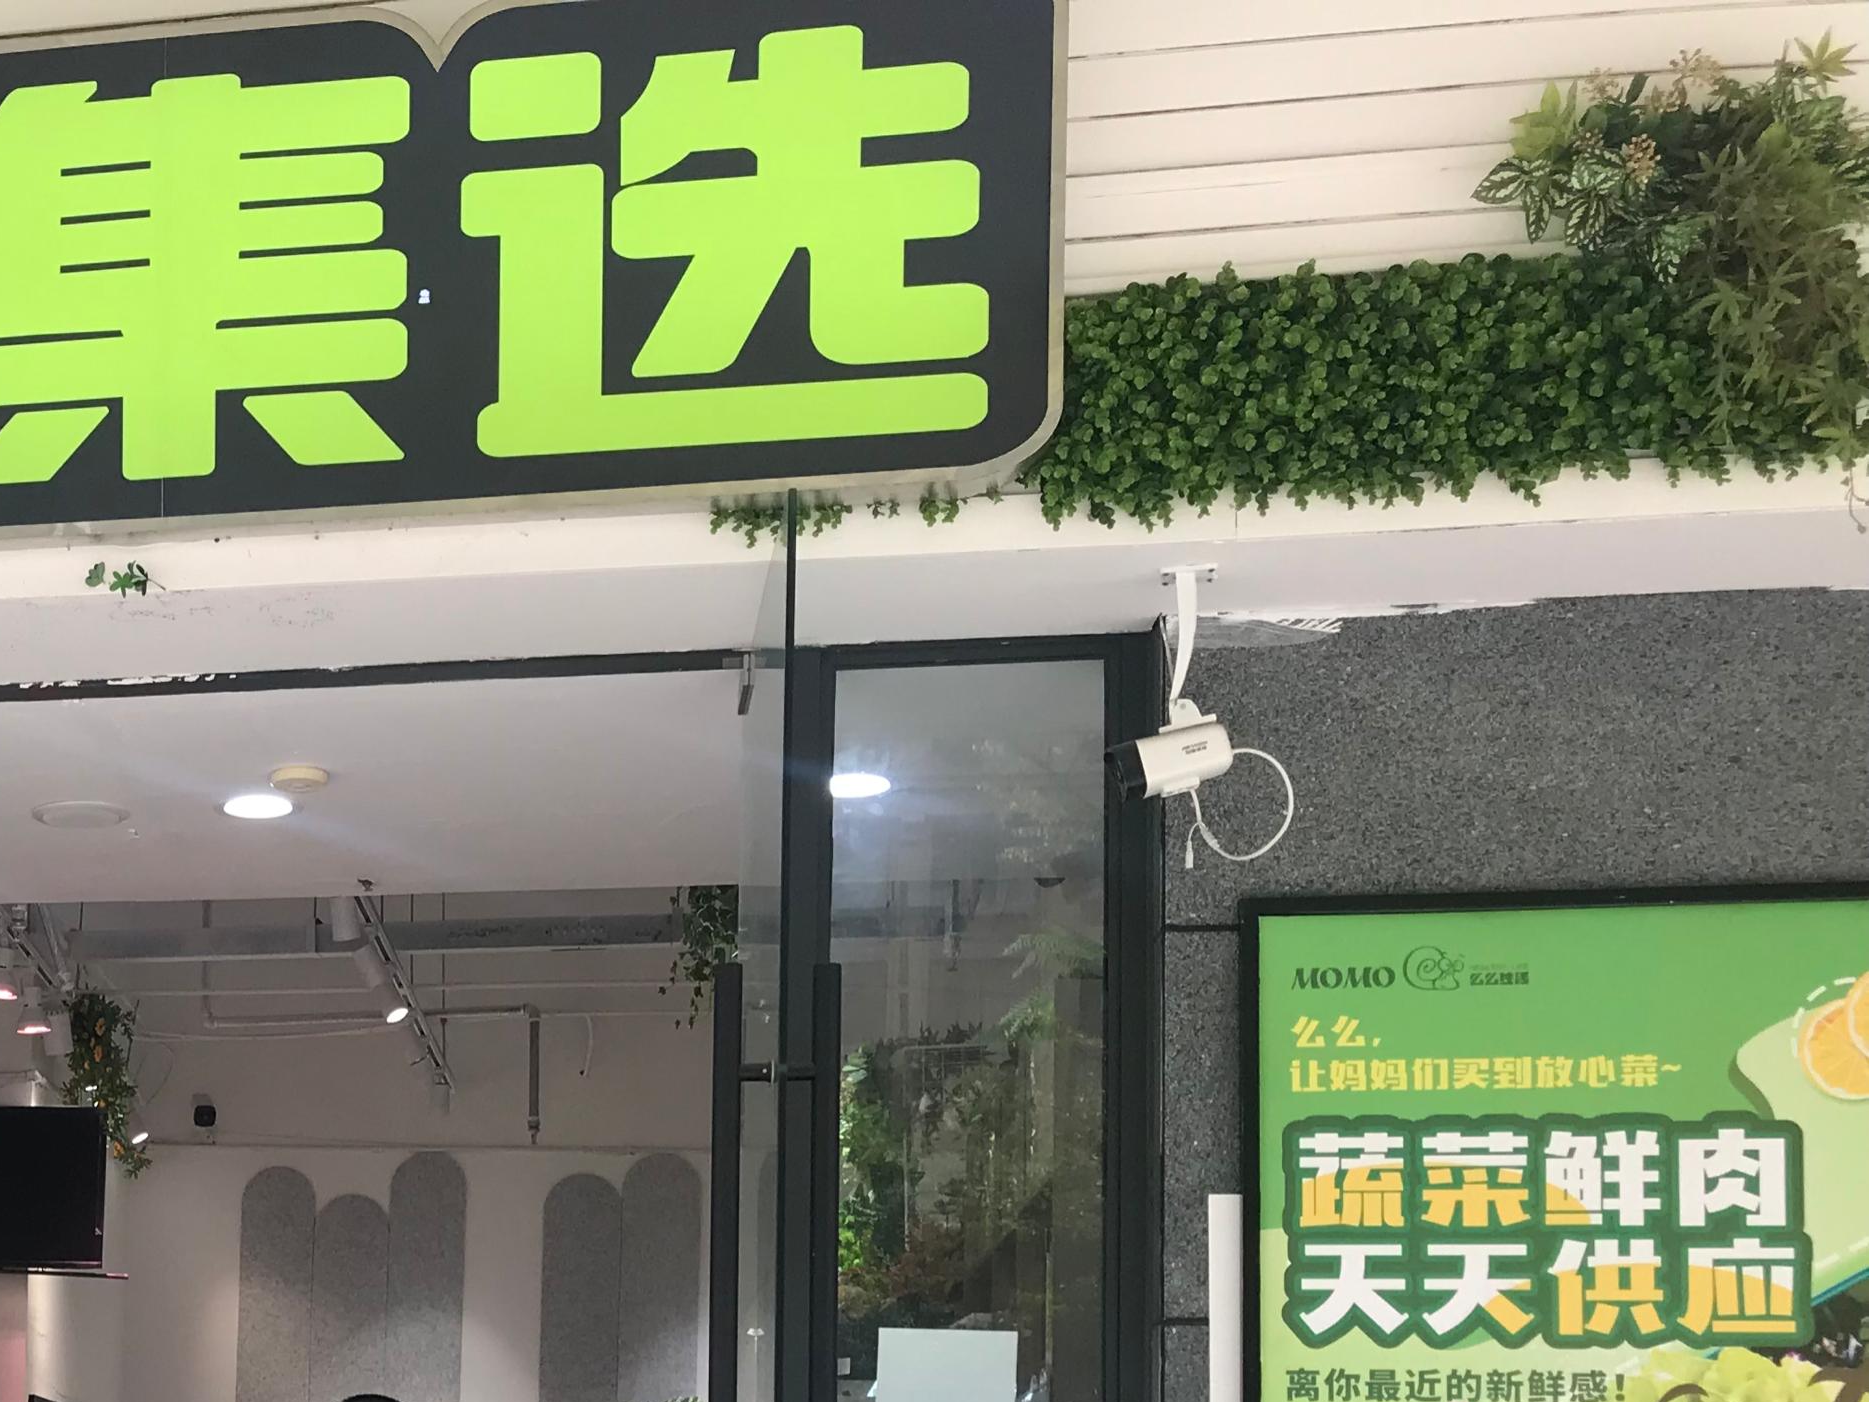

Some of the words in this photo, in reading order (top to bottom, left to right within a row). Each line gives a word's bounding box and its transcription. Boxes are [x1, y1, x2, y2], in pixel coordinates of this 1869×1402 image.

[1291, 966, 1396, 990] MOMO
[1298, 1128, 1787, 1229] 蔬菜鲜肉
[1299, 1238, 1798, 1336] 天天供应
